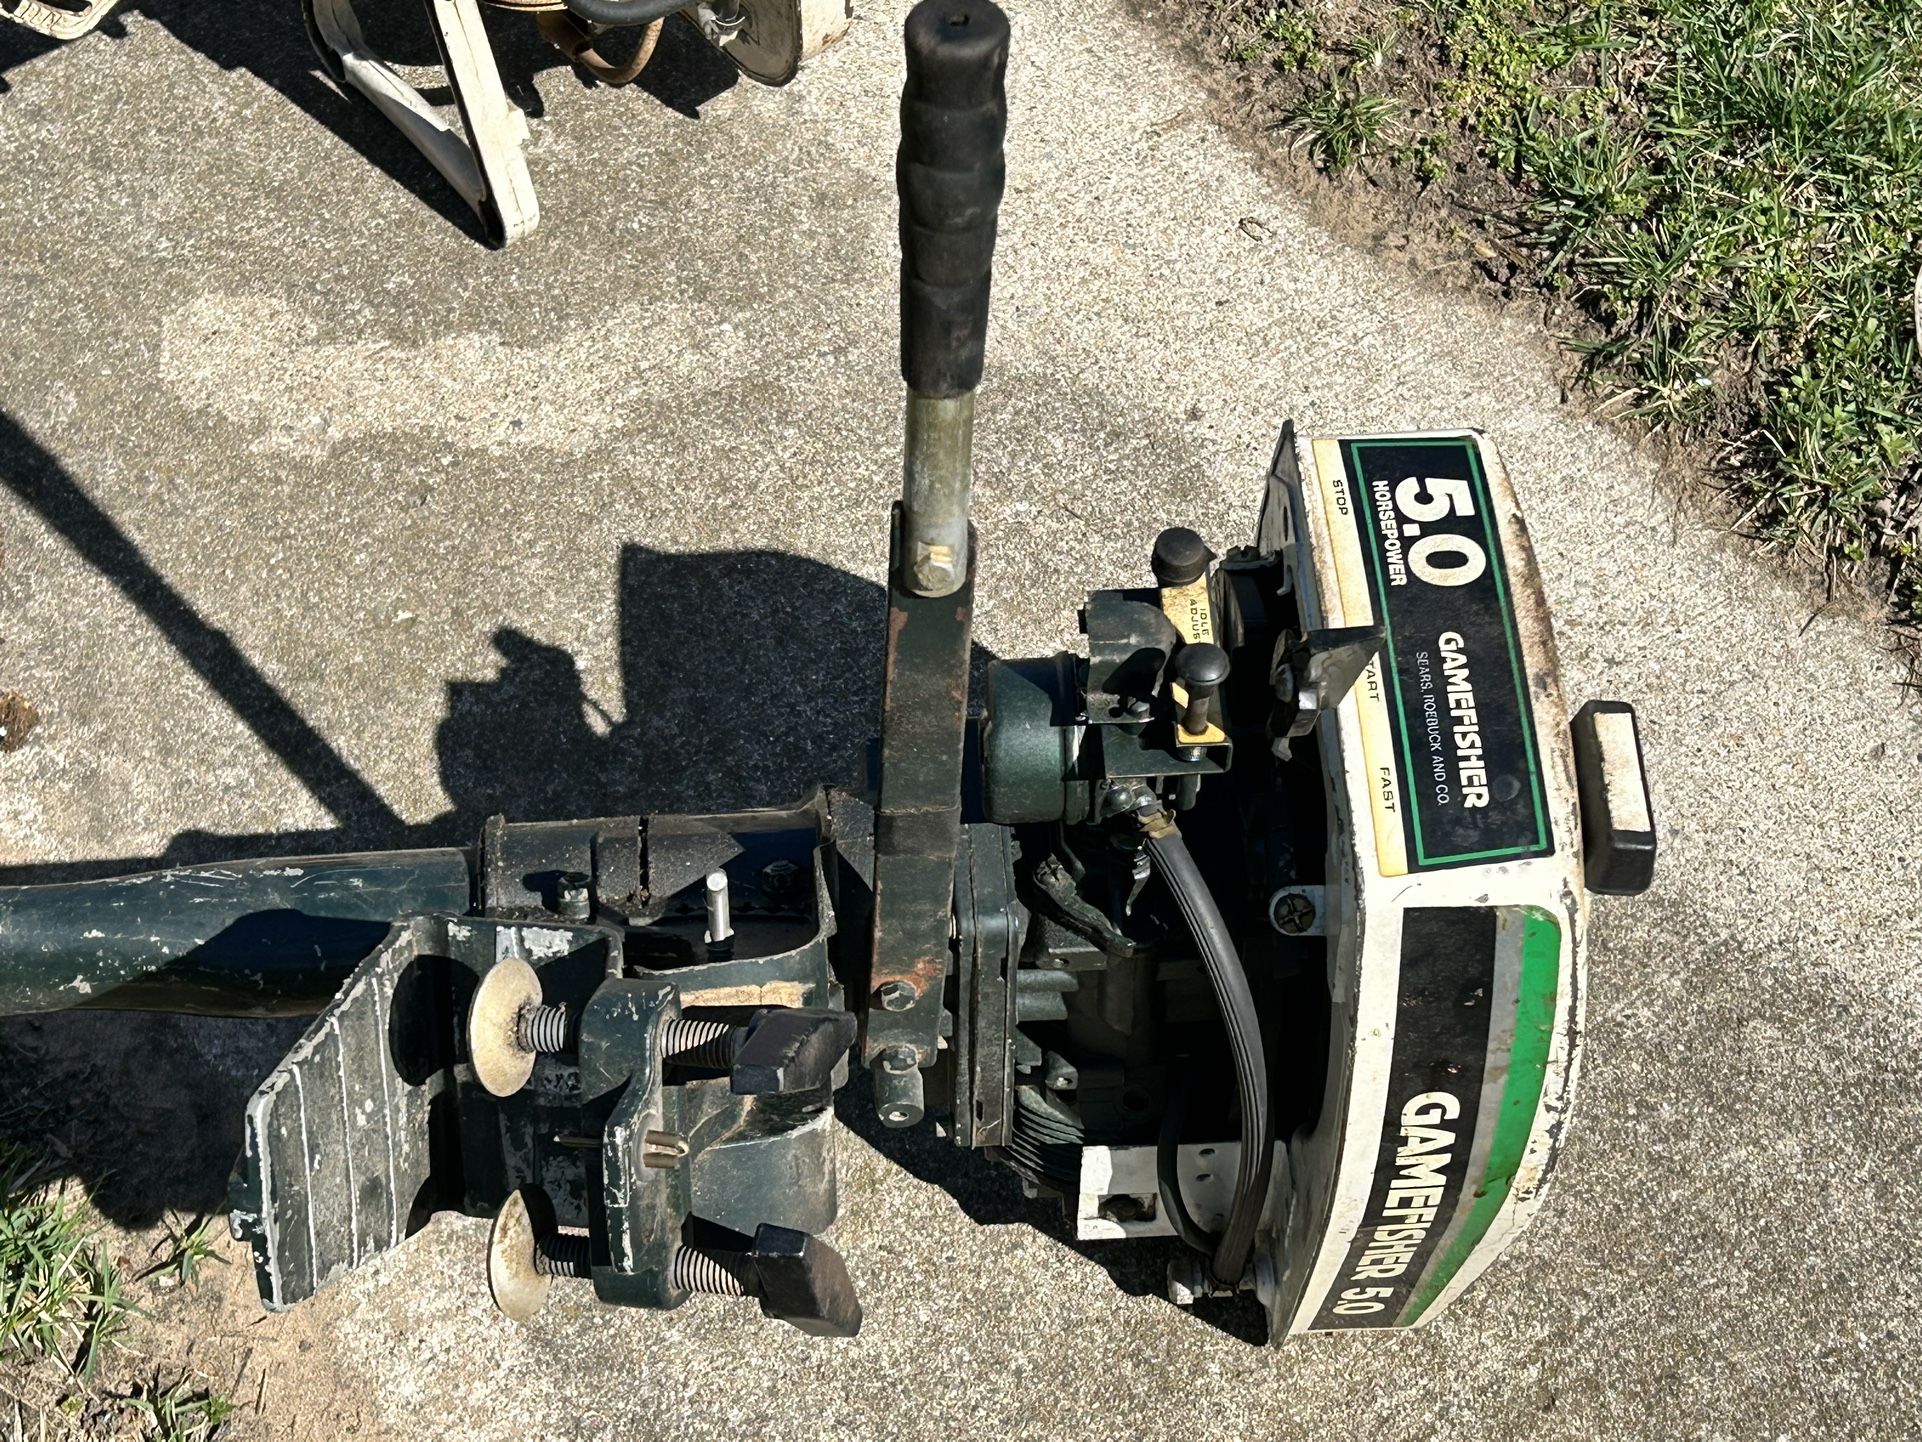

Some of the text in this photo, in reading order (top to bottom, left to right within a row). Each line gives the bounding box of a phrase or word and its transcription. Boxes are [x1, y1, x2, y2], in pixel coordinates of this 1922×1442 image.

[1332, 479, 1349, 516] STOP
[1372, 480, 1408, 586] HORSEPOWER
[1395, 476, 1486, 587] 5.0
[1190, 599, 1201, 642] ADJUS
[1200, 608, 1210, 636] IDLE
[1365, 659, 1380, 702] TART
[1416, 651, 1433, 693] SEARS,
[1423, 694, 1442, 751] ROEBUCK
[1438, 631, 1490, 809] GAMEFISHER
[1379, 766, 1396, 813] FAST
[1432, 756, 1446, 783] AND
[1332, 1091, 1461, 1315] GAMEFISHER 5.0
